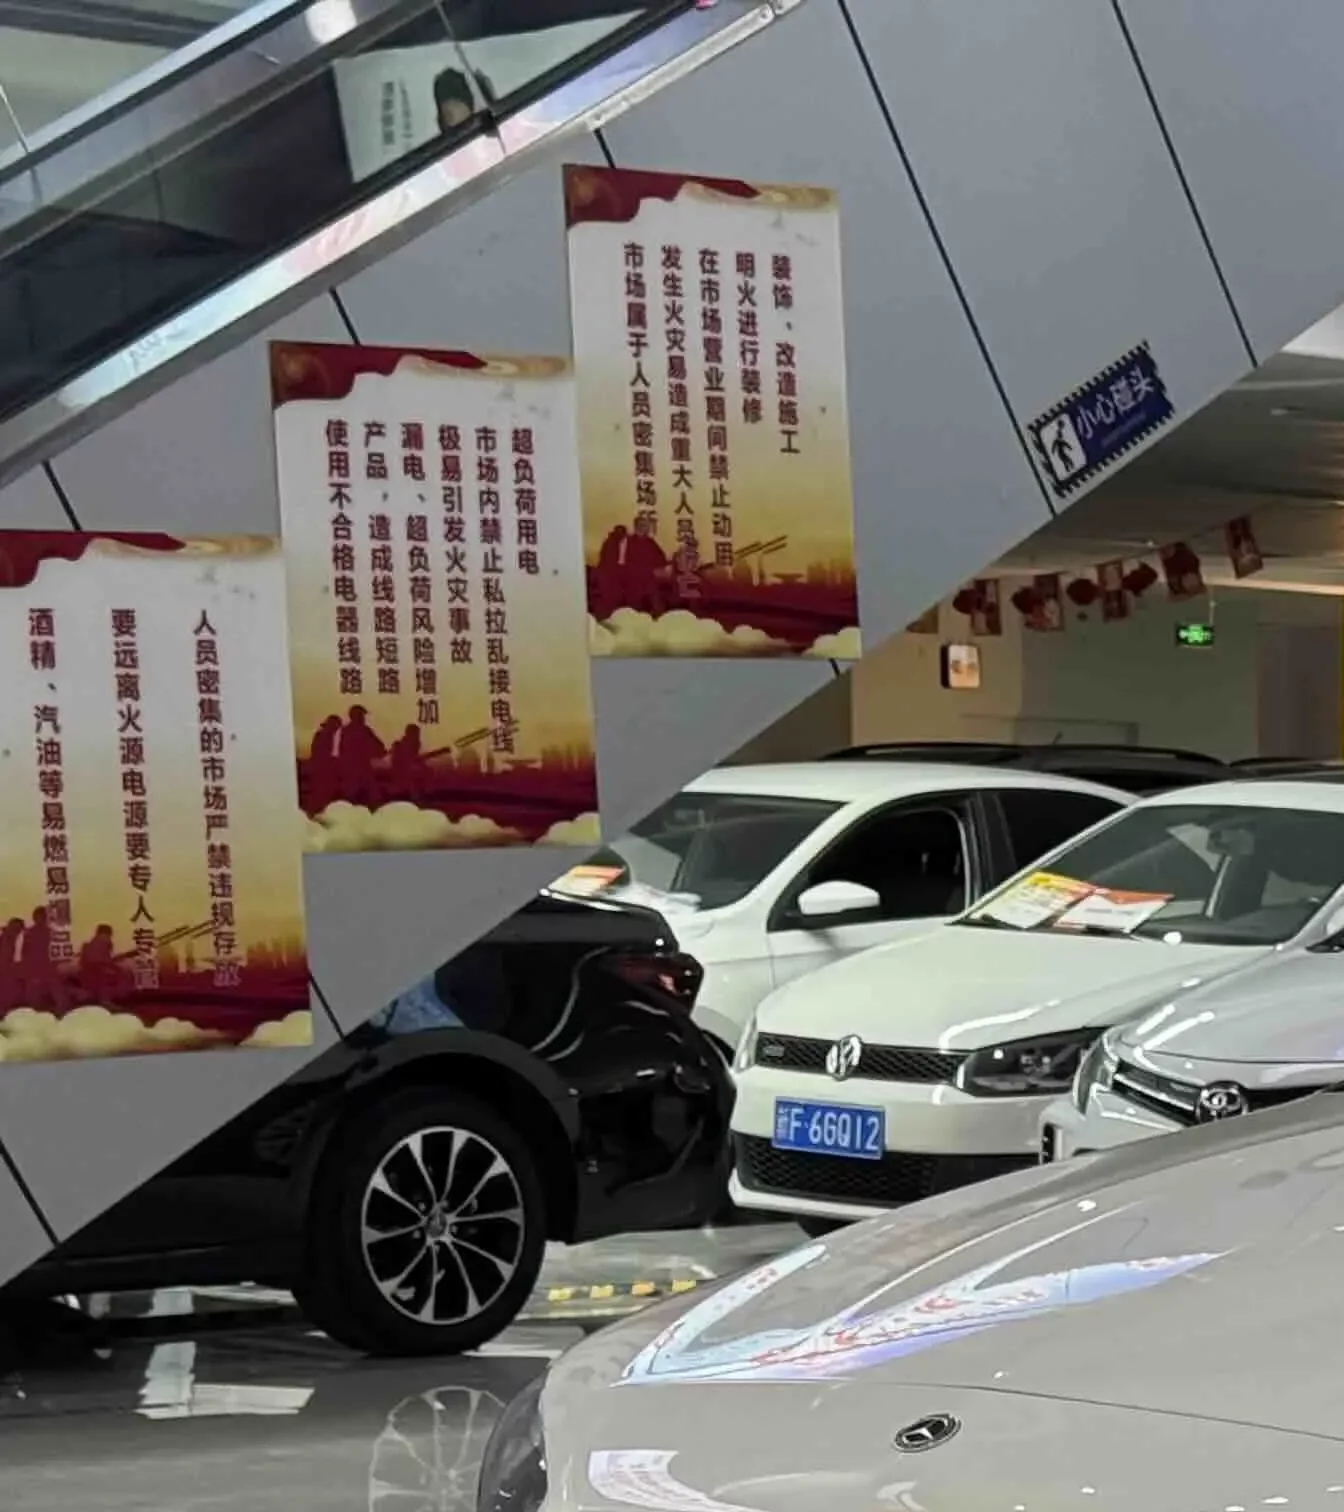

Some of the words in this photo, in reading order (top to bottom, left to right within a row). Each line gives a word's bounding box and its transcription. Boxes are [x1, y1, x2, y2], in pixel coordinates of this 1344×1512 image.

[623, 241, 657, 537] 市场属于人员密集场所
[735, 251, 762, 424] 明火进行装修
[325, 419, 363, 694] 使用不合格电器线路
[438, 424, 473, 664] 极易引发火灾事故
[511, 428, 540, 574] 超负荷用电
